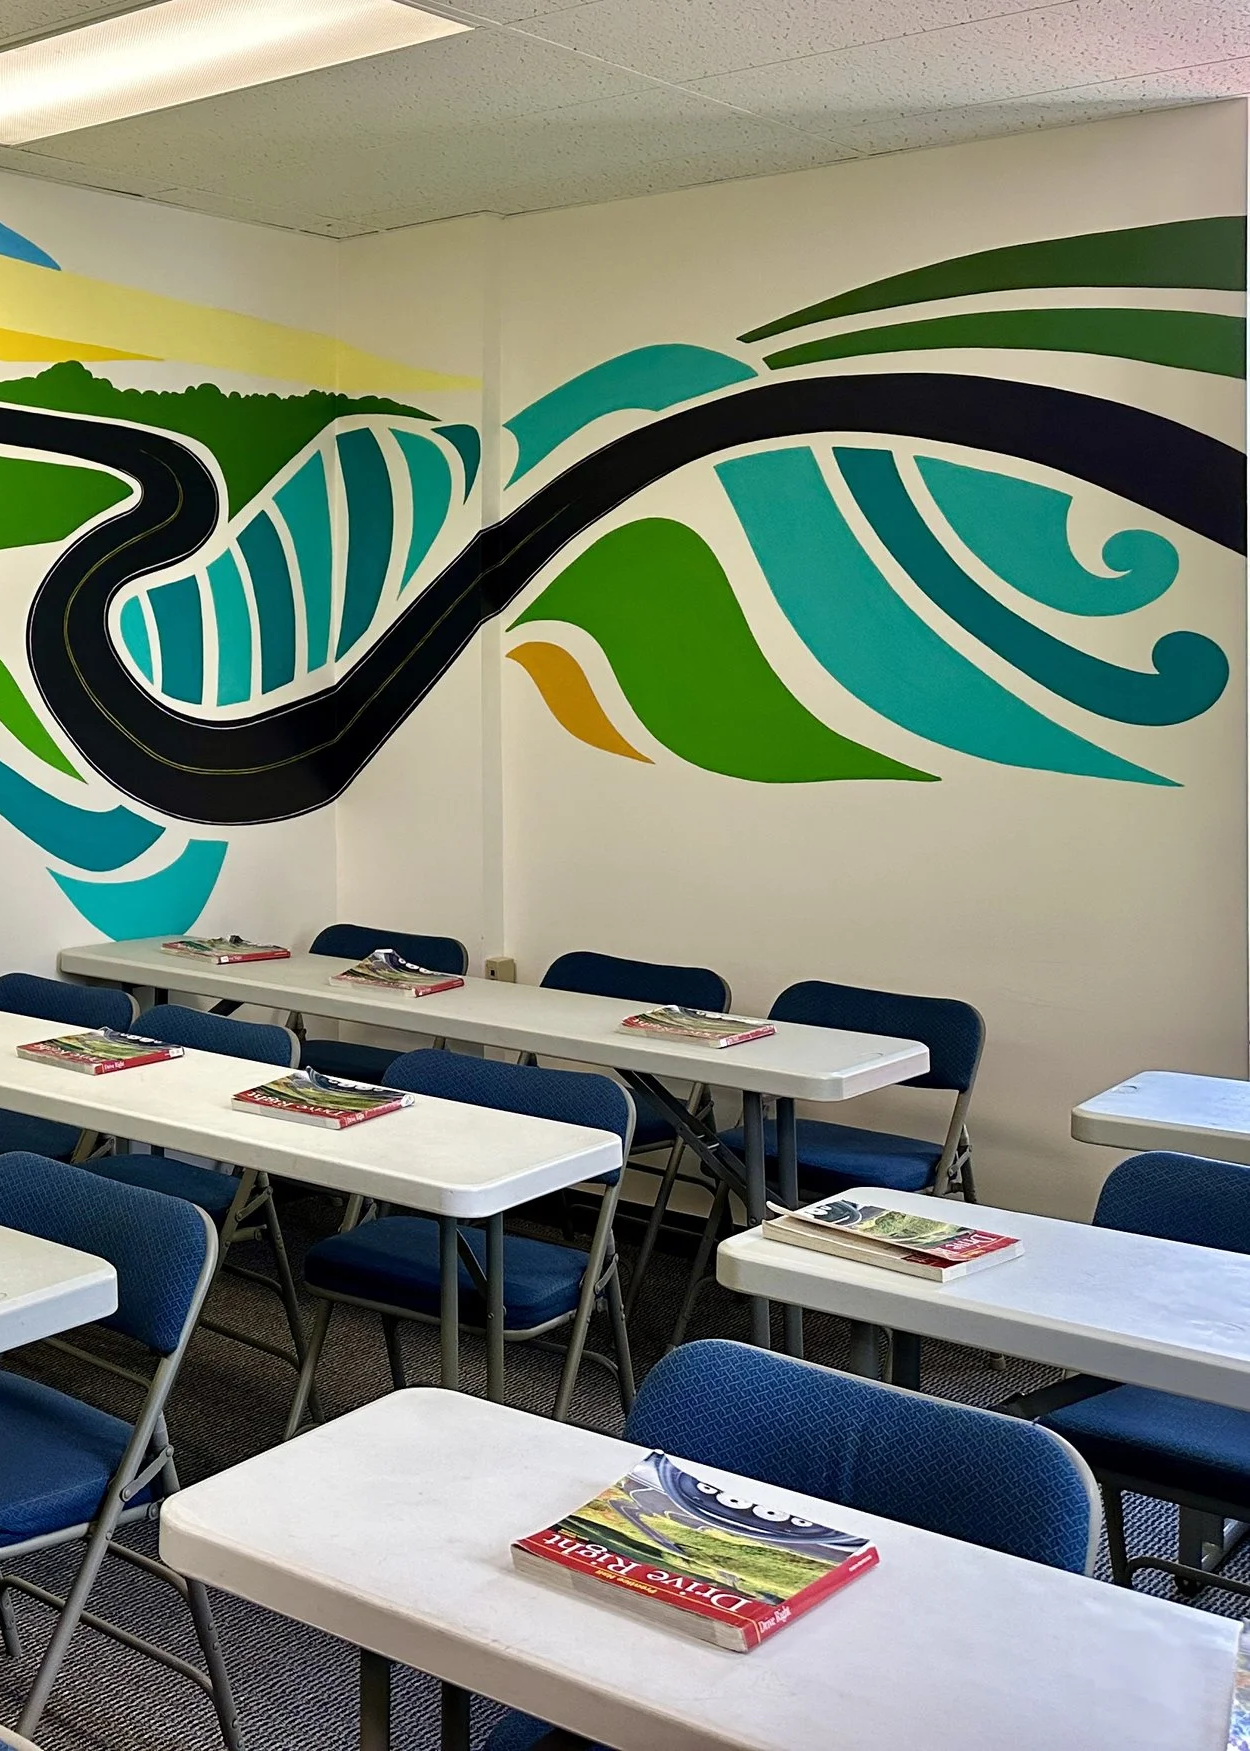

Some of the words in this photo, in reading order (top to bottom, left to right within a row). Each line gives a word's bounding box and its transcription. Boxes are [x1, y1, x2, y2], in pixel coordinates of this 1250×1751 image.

[542, 1533, 644, 1576] Right
[647, 1571, 753, 1613] Drive
[758, 1616, 776, 1634] Drive
[774, 1605, 792, 1623] Right
